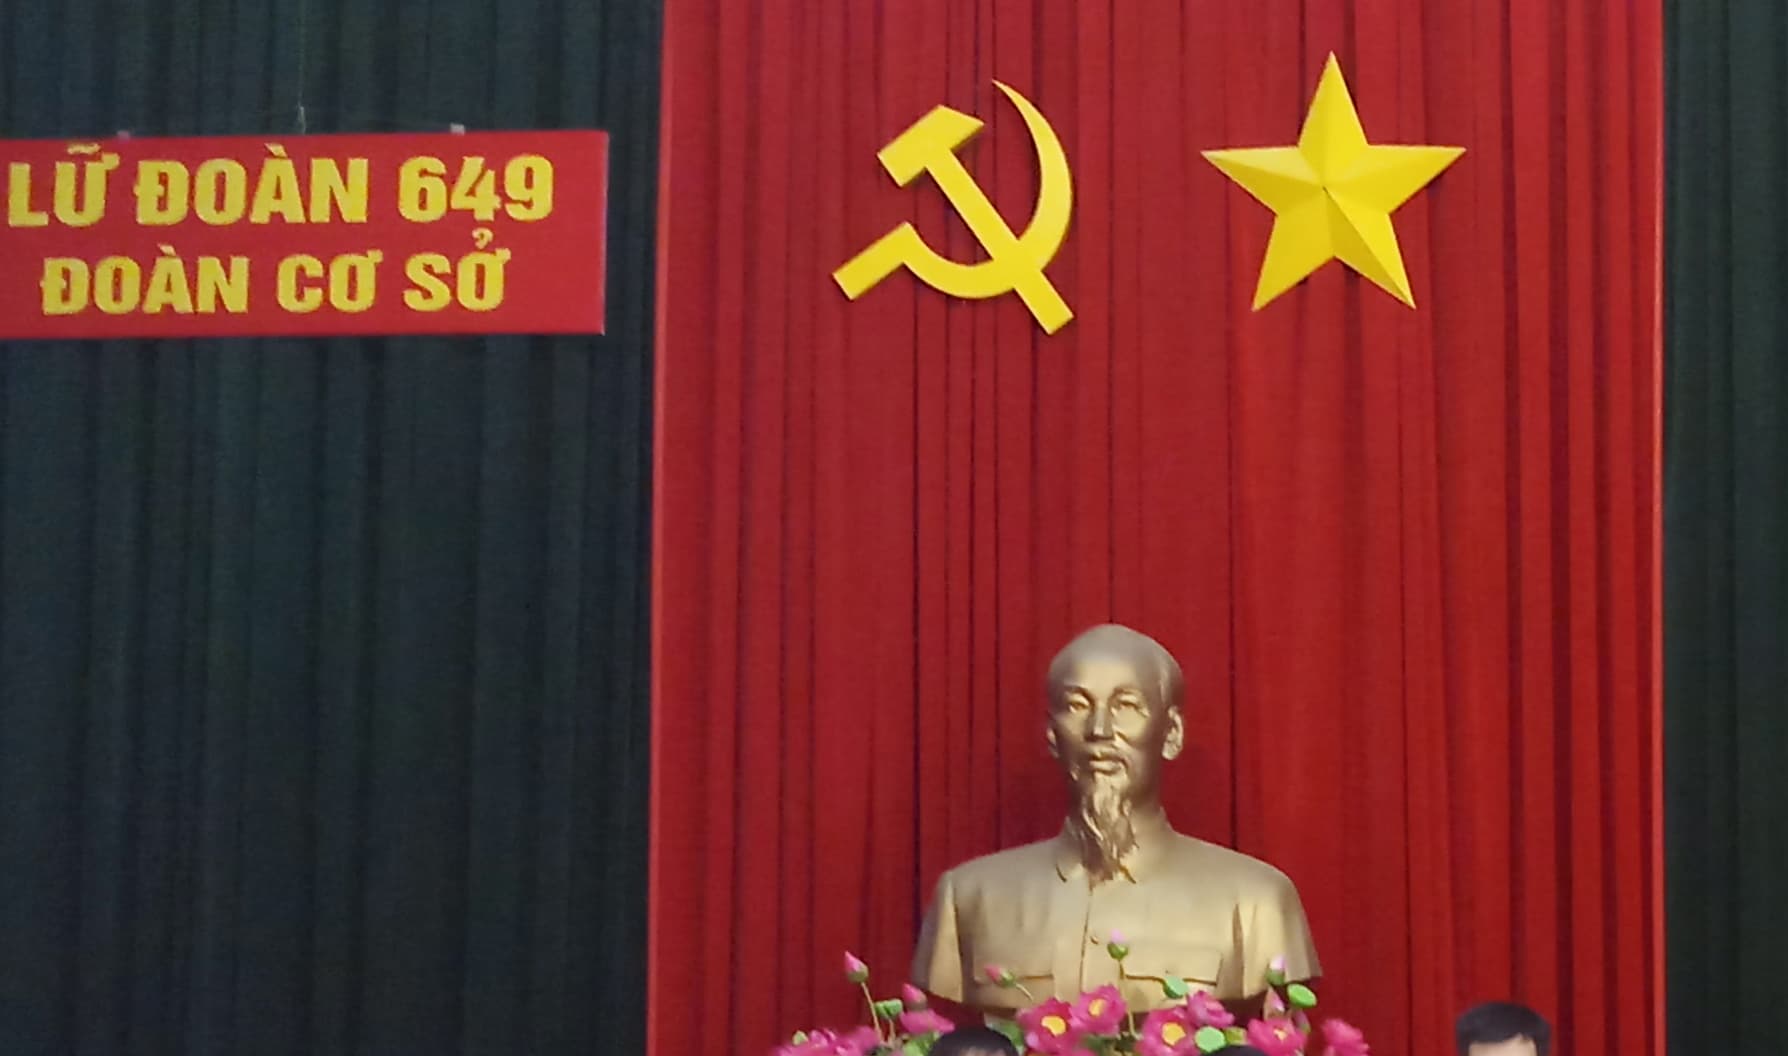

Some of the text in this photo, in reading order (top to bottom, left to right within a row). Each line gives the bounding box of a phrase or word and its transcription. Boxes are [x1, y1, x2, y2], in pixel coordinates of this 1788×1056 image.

[8, 143, 554, 227] LỮ ĐOÀN 649
[39, 227, 512, 315] ĐOÀN CƠ SỞ
